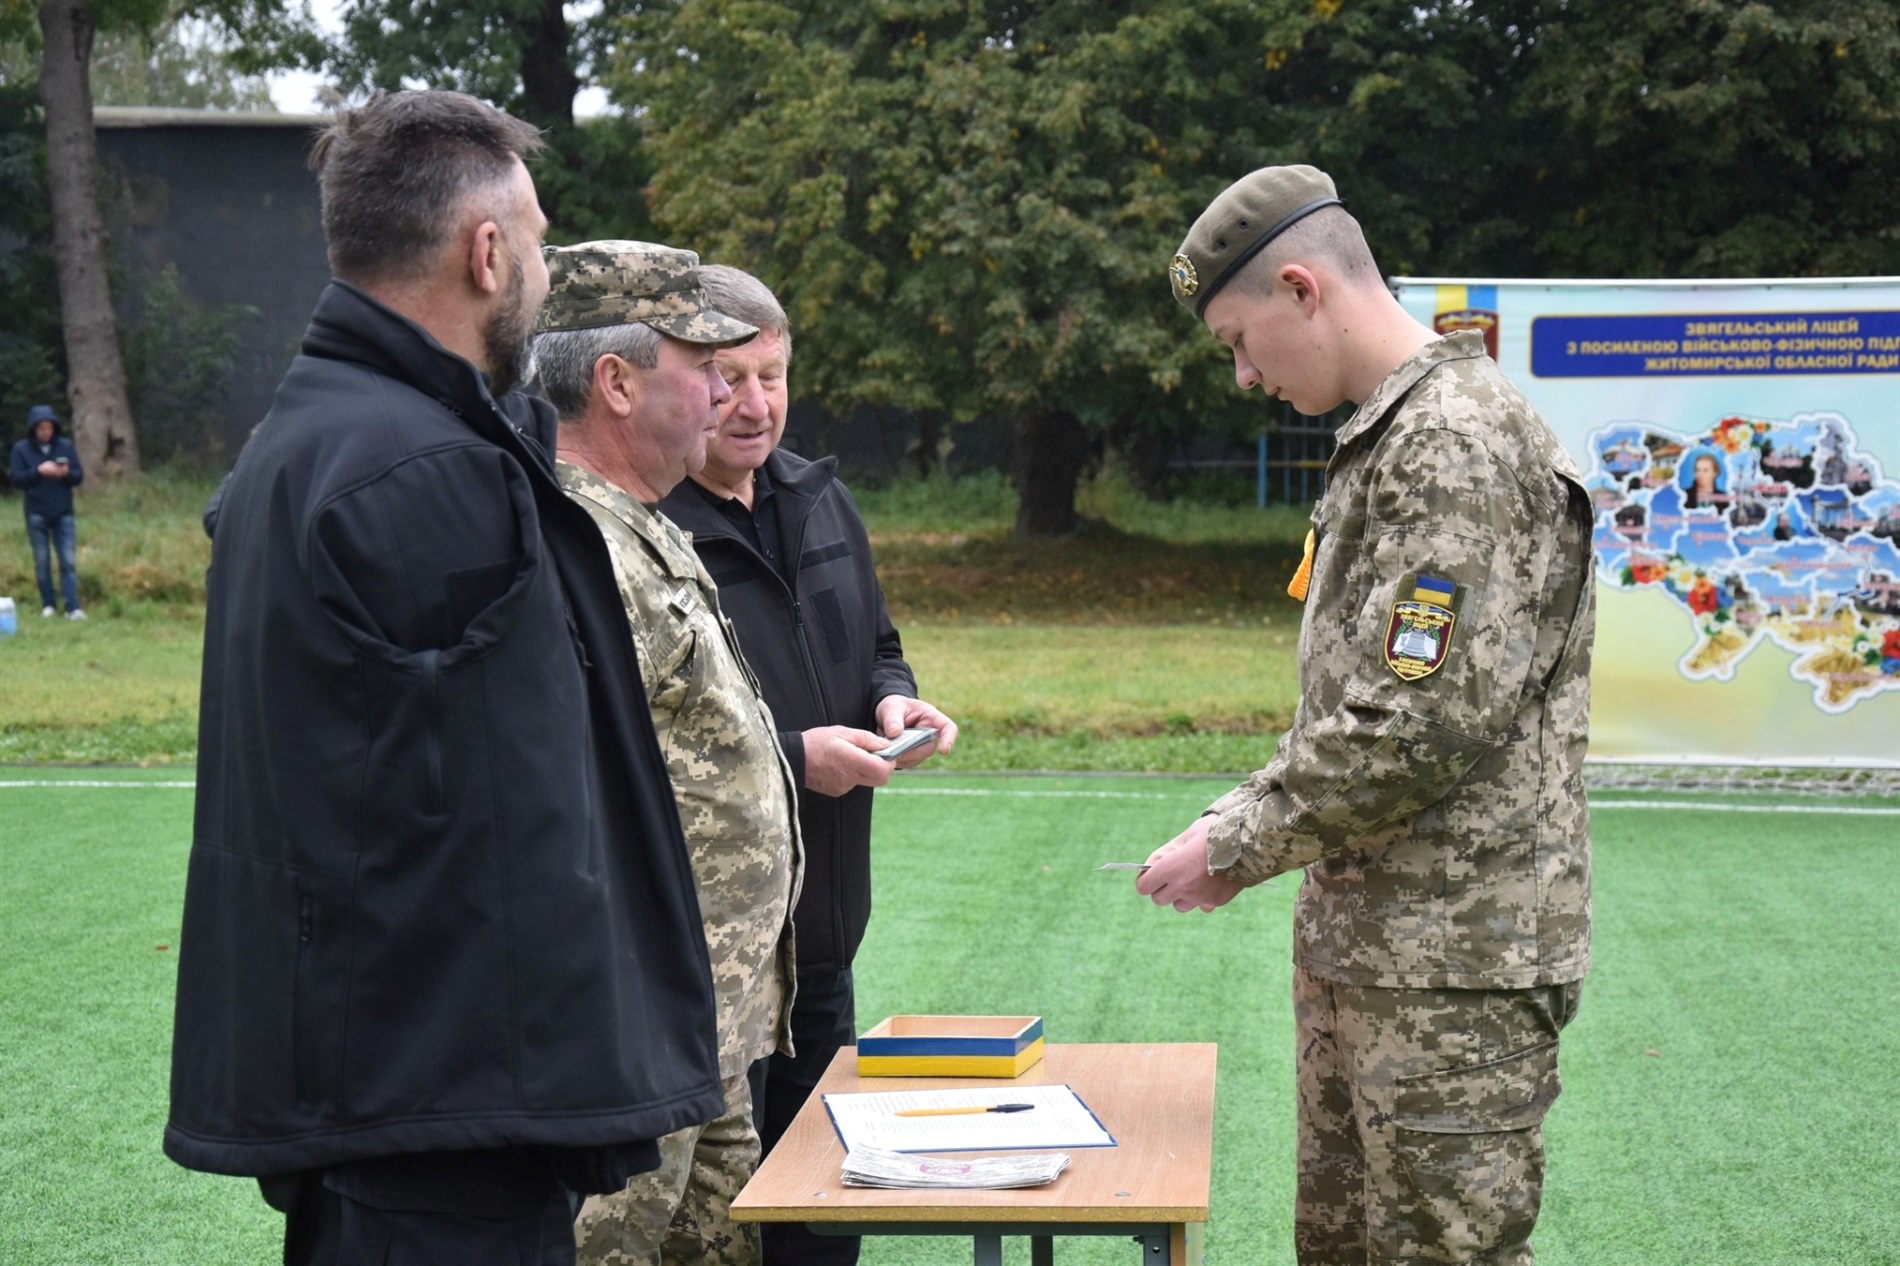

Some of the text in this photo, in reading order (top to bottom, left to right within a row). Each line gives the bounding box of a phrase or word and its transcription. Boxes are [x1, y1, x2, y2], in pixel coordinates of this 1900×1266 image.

[1686, 317, 1859, 336] ЗВЯГЕЛЬСЬКИЙ ЛІЦЕЙ
[1566, 341, 1577, 355] З
[1580, 340, 1679, 355] ПОСИЛЕНОЮ
[1682, 337, 1864, 353] ВІЙСЬКОВО-ФІЗИЧНОЮ
[1644, 352, 1899, 370] ЖИТОМИРСЬКОЇ ОБЛАСНОЇ РАДИ
